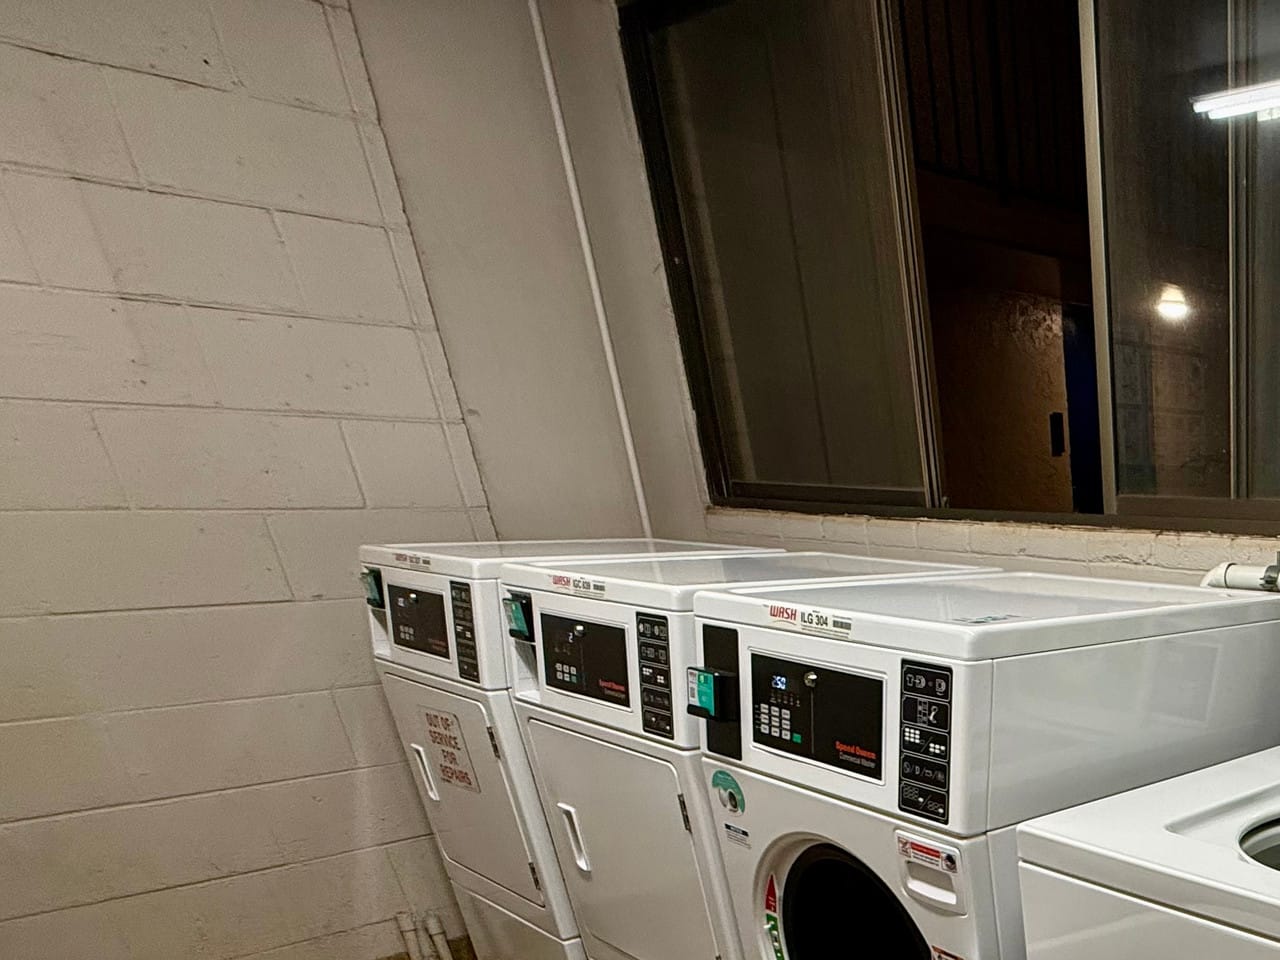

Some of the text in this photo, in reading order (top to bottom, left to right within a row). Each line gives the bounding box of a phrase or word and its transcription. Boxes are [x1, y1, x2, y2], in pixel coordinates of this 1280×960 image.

[770, 605, 828, 627] WASH ILG 304
